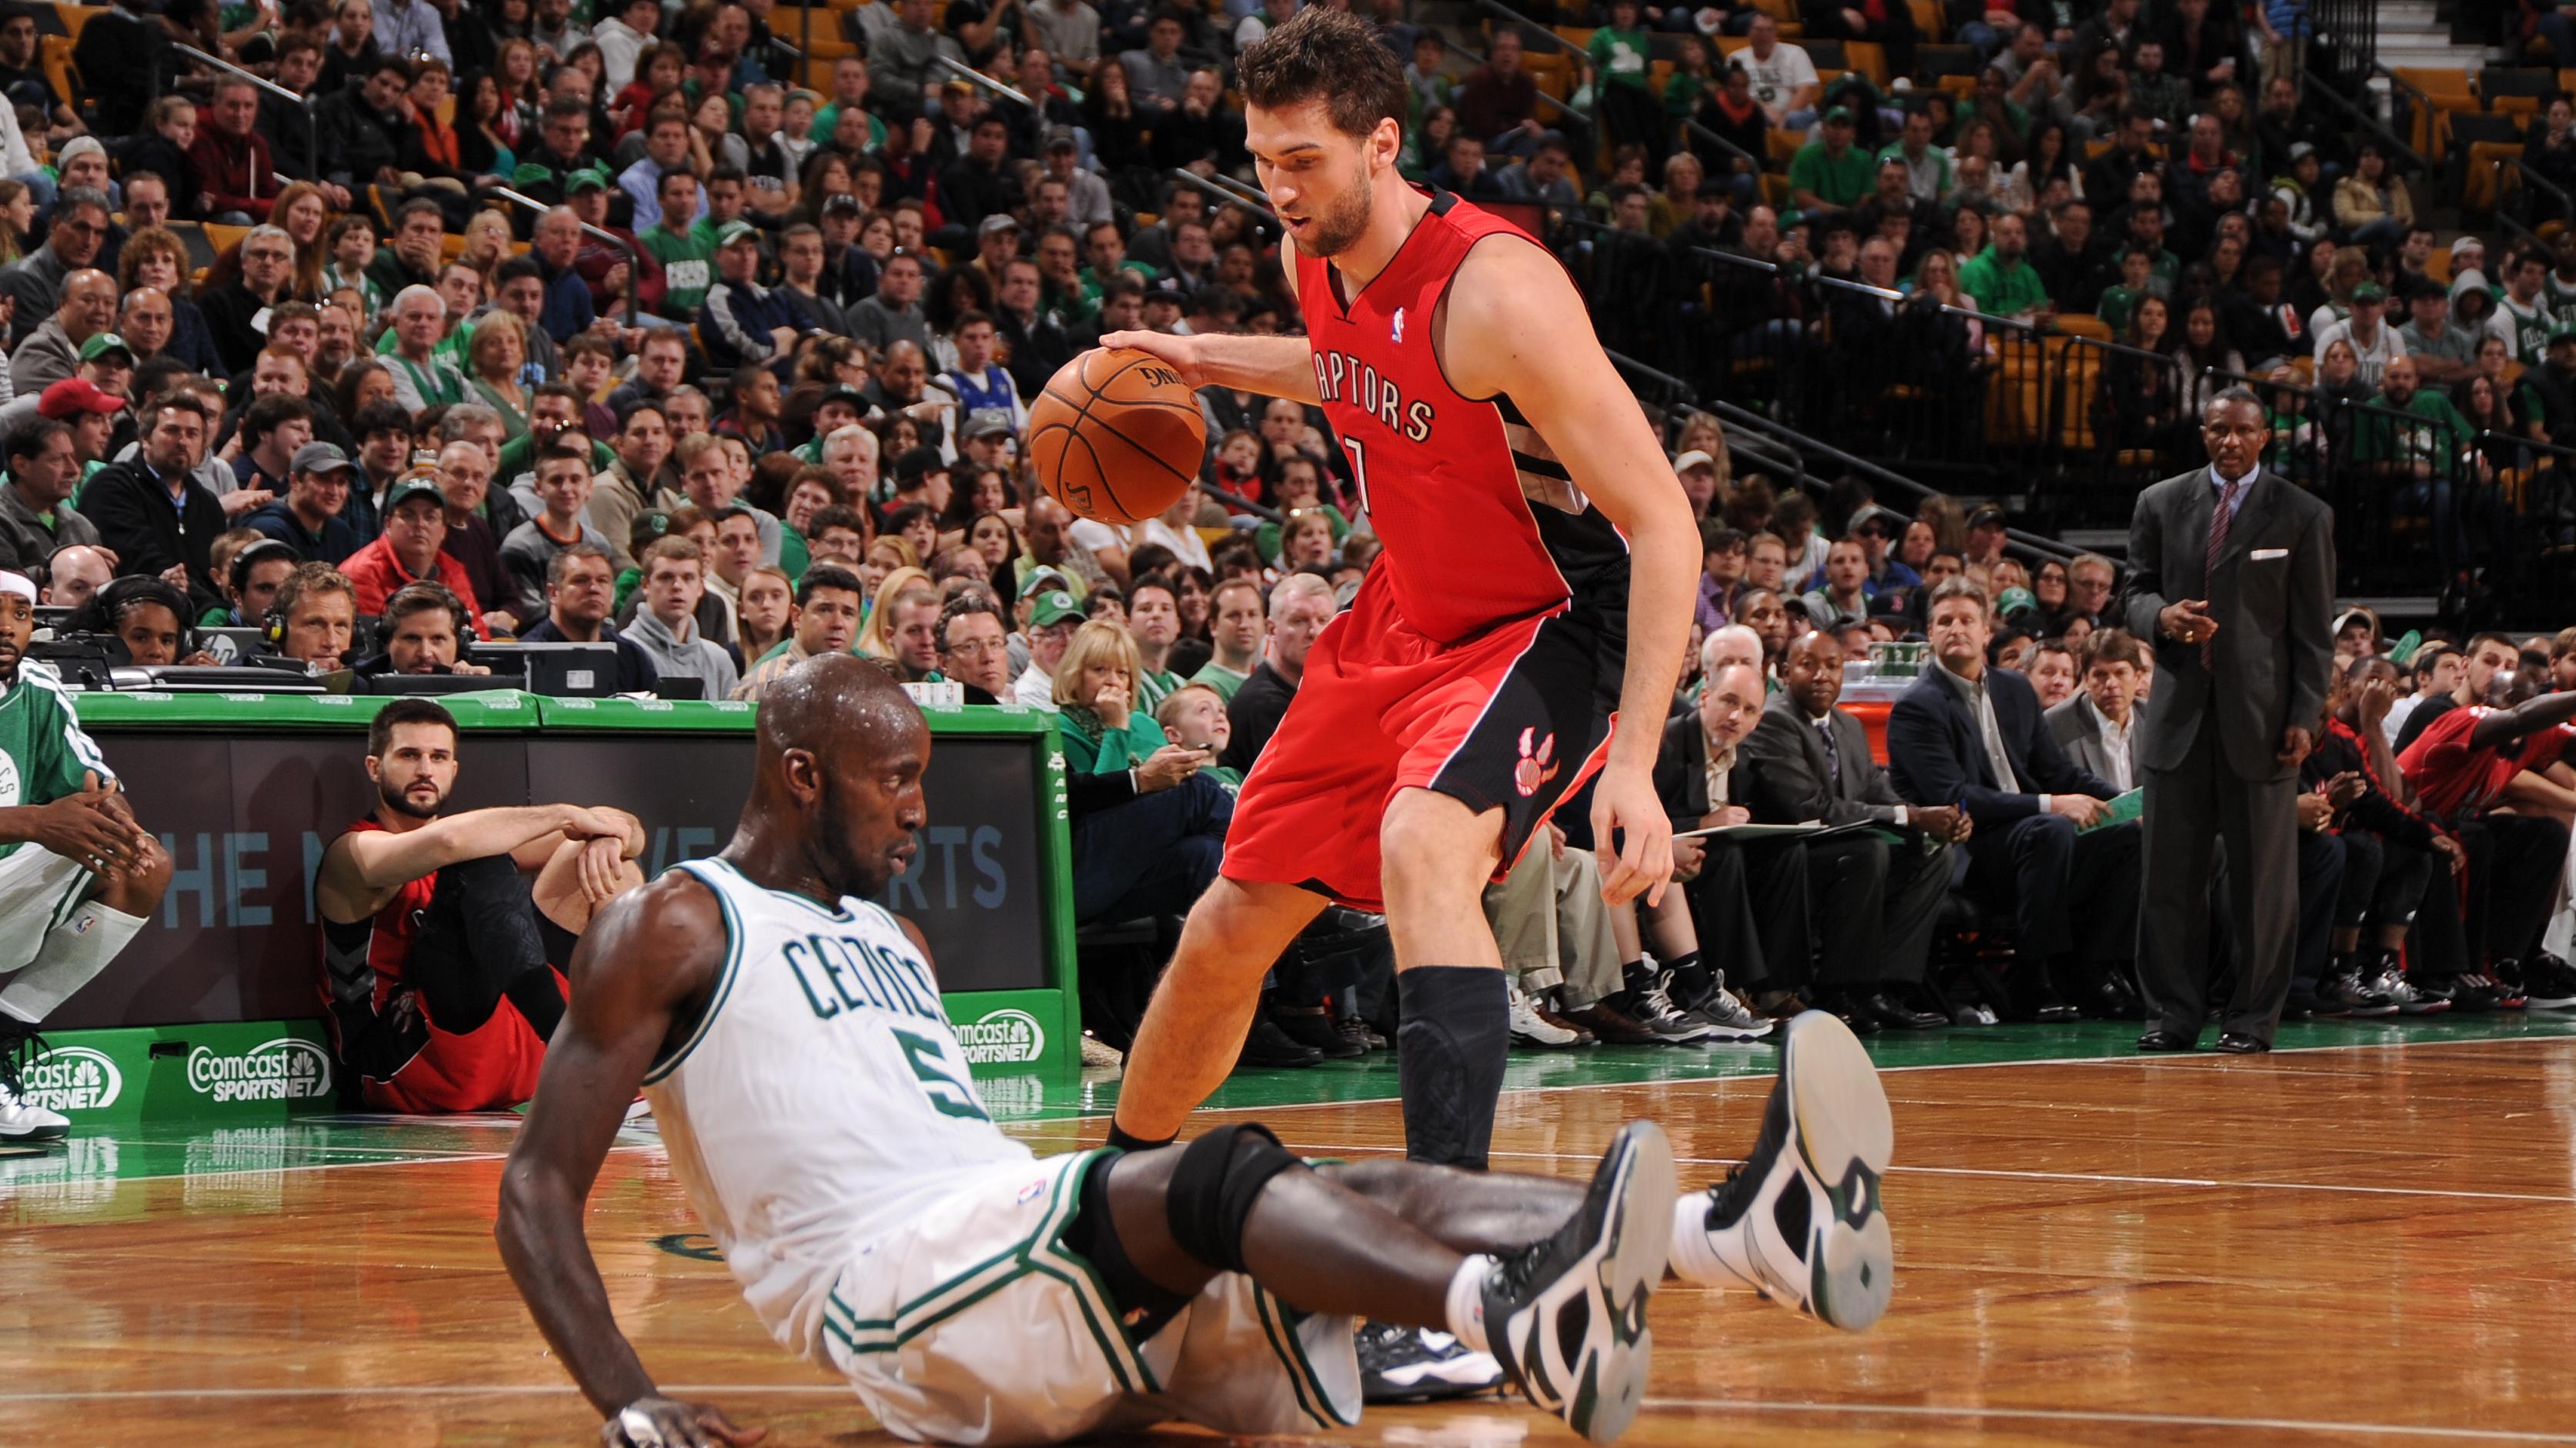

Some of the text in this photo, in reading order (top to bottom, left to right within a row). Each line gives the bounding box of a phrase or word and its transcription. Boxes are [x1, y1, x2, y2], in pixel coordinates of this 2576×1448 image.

[1314, 350, 1435, 443] APTORS
[160, 831, 273, 929] HE
[888, 824, 1008, 910] RTS
[22, 1059, 73, 1089] cast
[888, 1026, 991, 1124] 5
[961, 1043, 1030, 1064] PORTSNET
[22, 1087, 101, 1110] RTSNET
[213, 1077, 316, 1103] SPORTSNET
